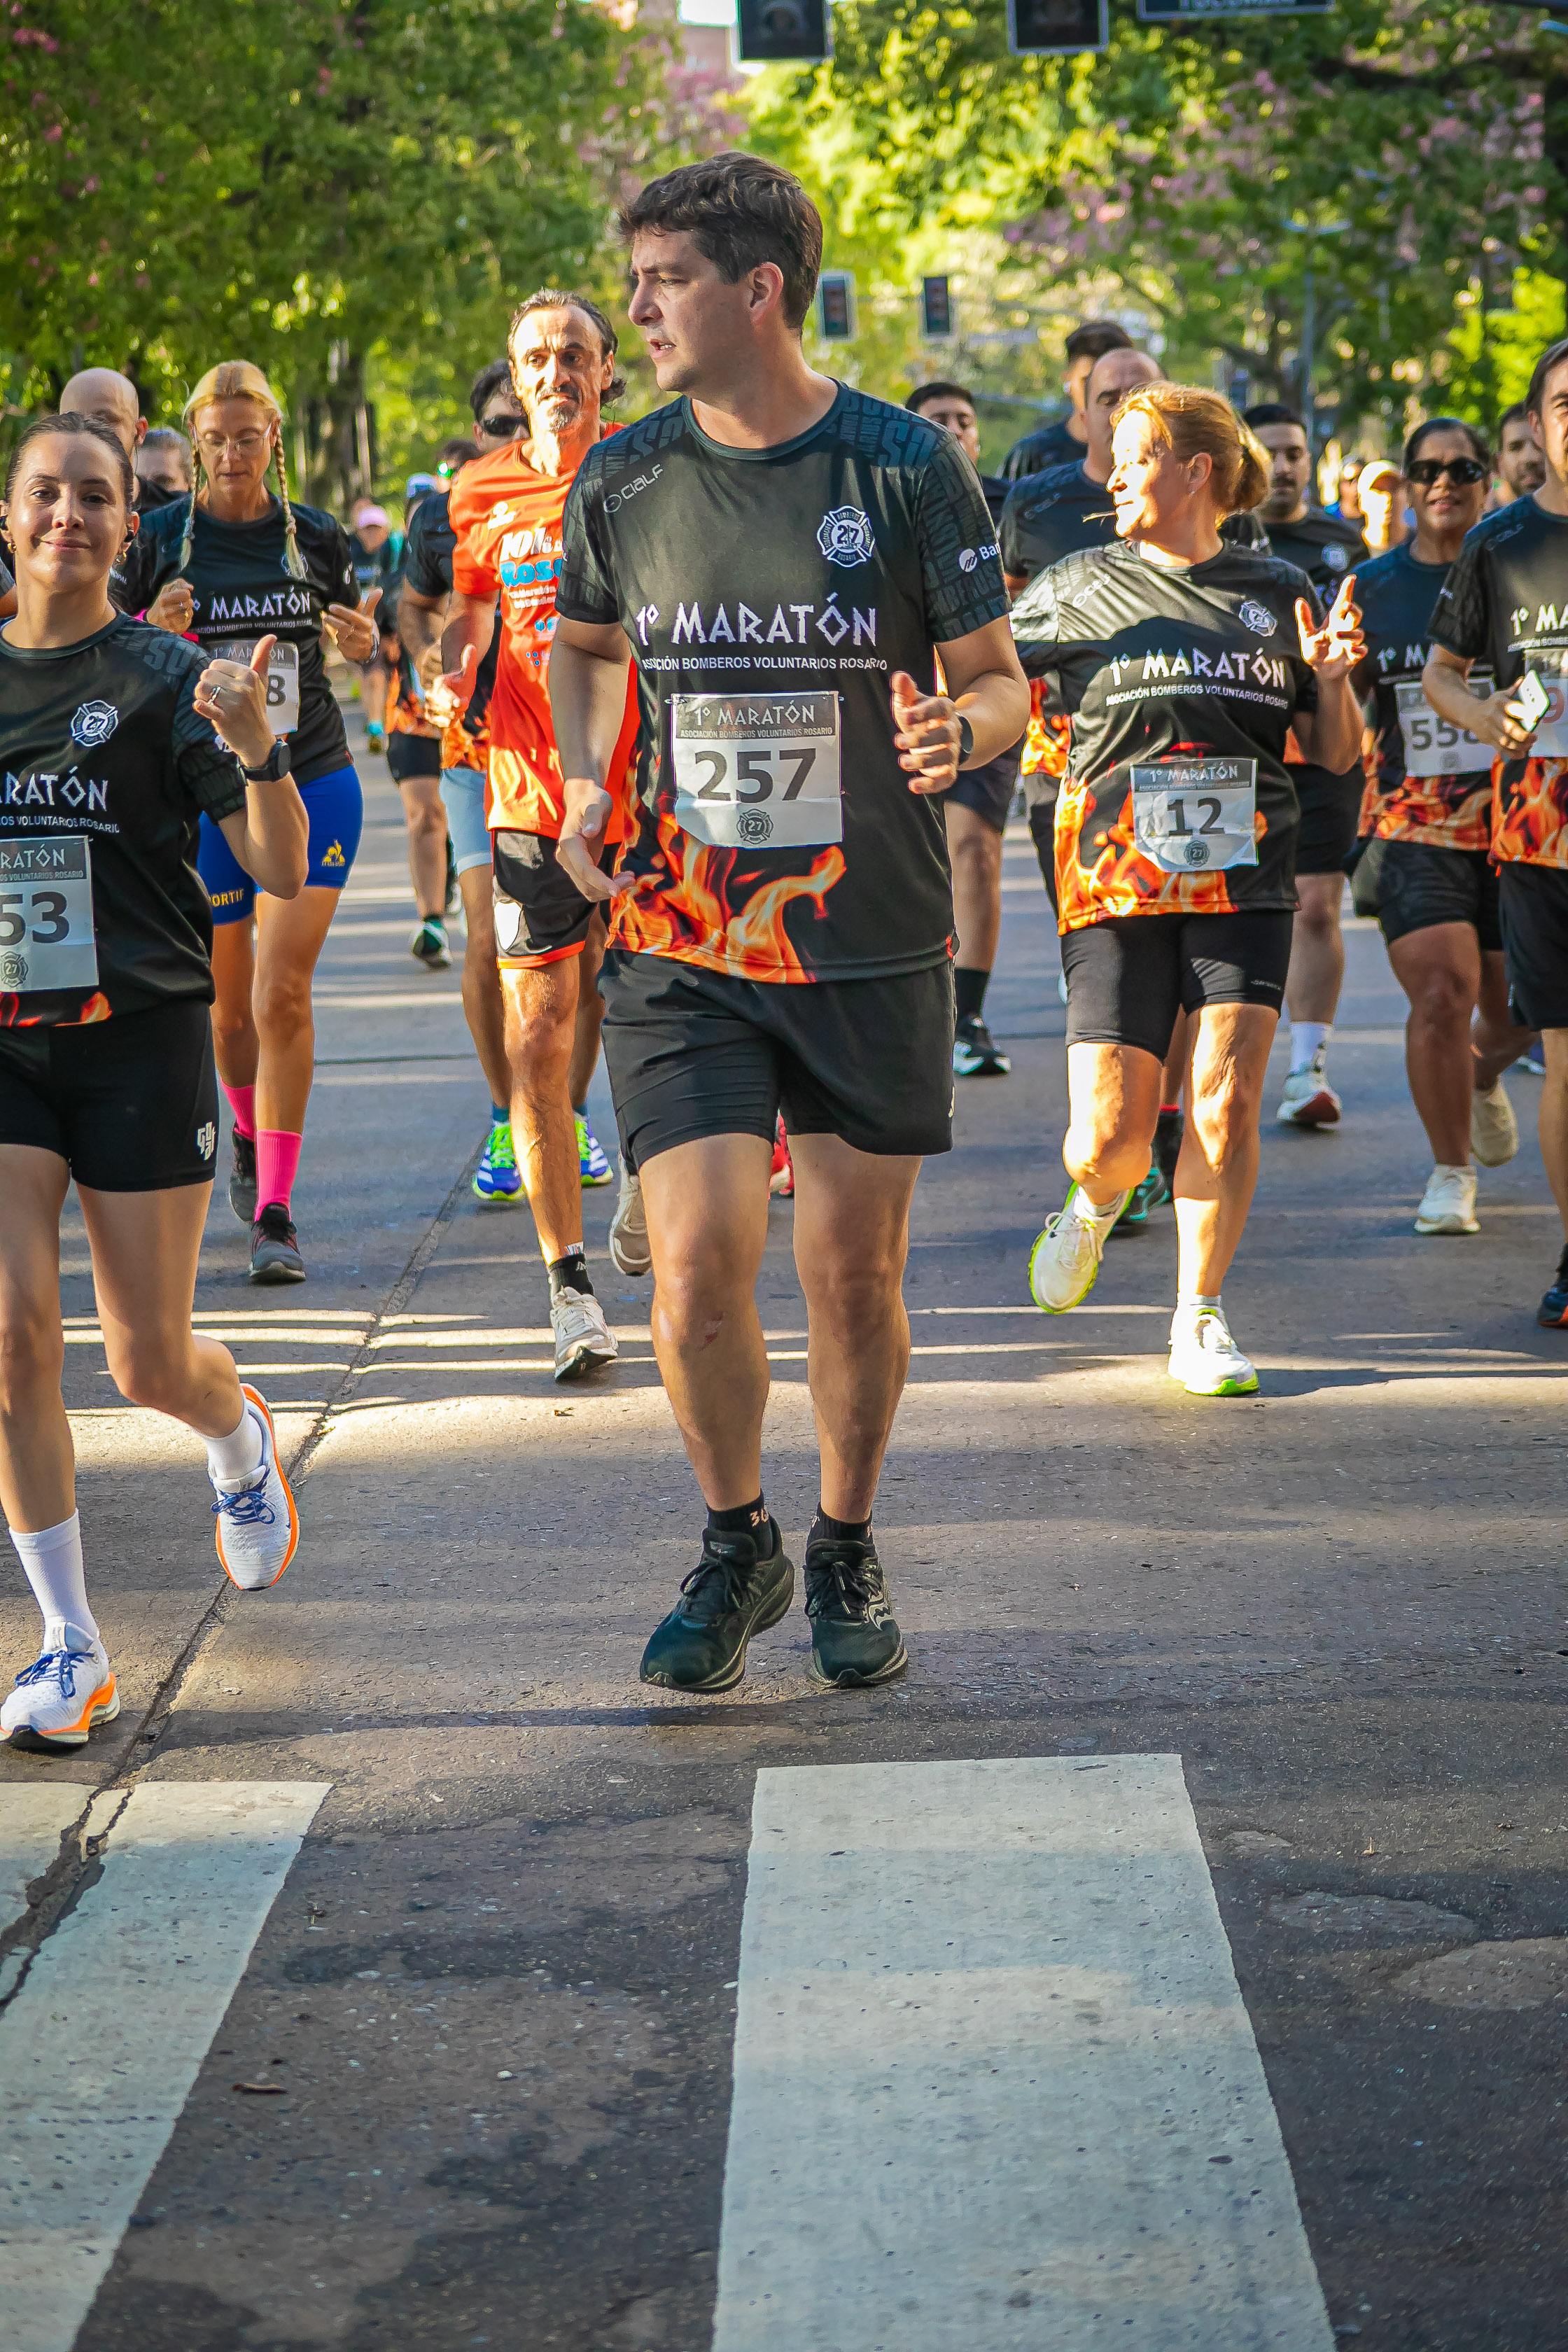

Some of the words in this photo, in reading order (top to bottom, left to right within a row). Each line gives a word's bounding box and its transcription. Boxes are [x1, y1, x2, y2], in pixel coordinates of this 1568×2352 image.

[837, 524, 860, 545] 27
[211, 585, 310, 620] MARATÓN
[671, 592, 877, 646] MARATÓN
[682, 657, 751, 670] BOMBEROS
[752, 657, 836, 670] VOLUNTARIOS
[840, 658, 888, 671] ROSARIO
[1142, 647, 1286, 689] MARATÓN
[1151, 683, 1204, 697] BOMBEROS
[1205, 685, 1264, 702] VOLUNTARIOS
[717, 699, 815, 726] MARATÓN
[85, 715, 106, 731] 27
[680, 729, 718, 738] ASOCIACIÓN
[720, 729, 756, 738] BOMBEROS
[757, 729, 802, 738] VOLUNTARIOS
[804, 727, 833, 736] ROSARIO
[694, 748, 817, 804] 257
[1167, 762, 1238, 782] MARATÓN
[0, 766, 108, 811] RATÓN
[18, 816, 78, 827] VOLUNTARIOS
[748, 820, 763, 832] 27
[1167, 797, 1224, 836] 12
[0, 844, 66, 869] RATÓN
[8, 872, 53, 881] VOLUNTARIOS
[55, 870, 84, 878] ROSARIO
[5, 962, 18, 975] 27
